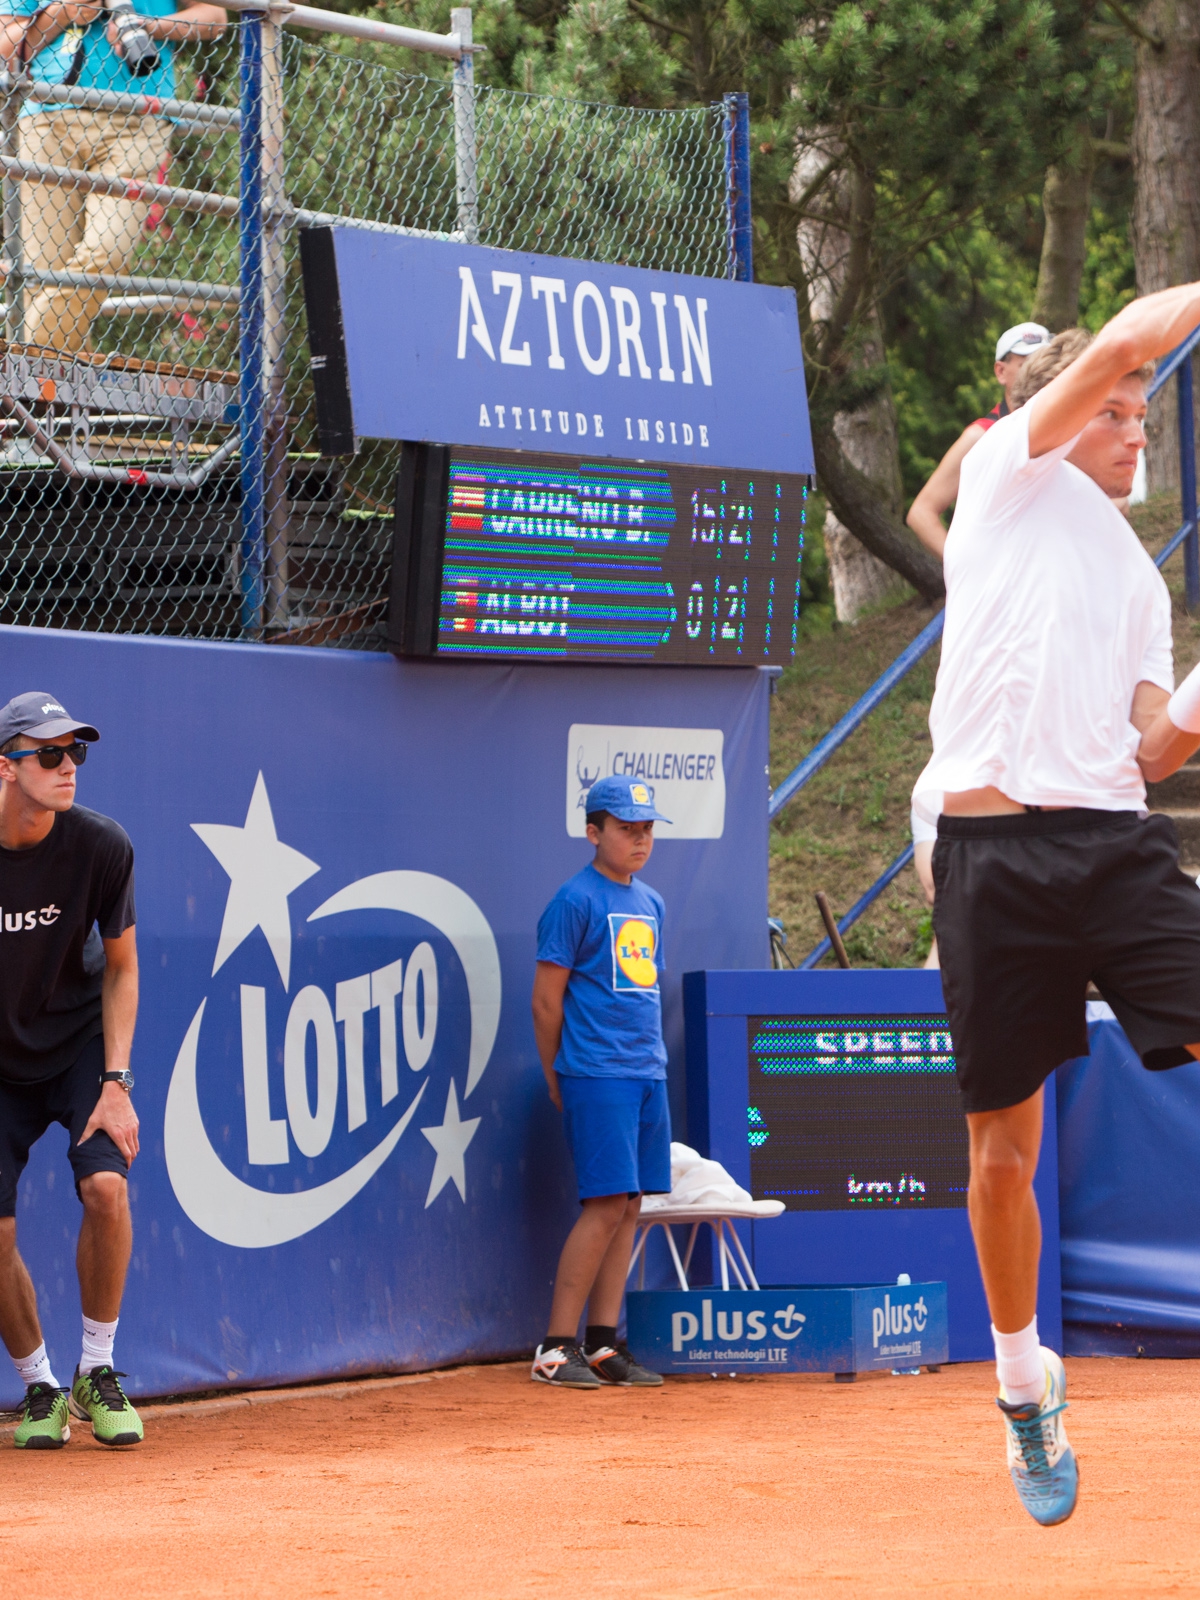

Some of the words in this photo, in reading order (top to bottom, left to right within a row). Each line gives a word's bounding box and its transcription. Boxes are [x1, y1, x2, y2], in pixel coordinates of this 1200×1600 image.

[457, 266, 712, 386] AZTORIN
[479, 404, 604, 437] ATTITUDE
[625, 418, 709, 447] INSIDE
[613, 751, 716, 781] CHALLENGER
[240, 941, 438, 1165] LOTTO
[672, 1299, 767, 1352] plus
[872, 1294, 912, 1348] plus
[689, 1350, 711, 1360] Lider
[714, 1349, 766, 1362] technologii
[768, 1348, 787, 1361] LTE
